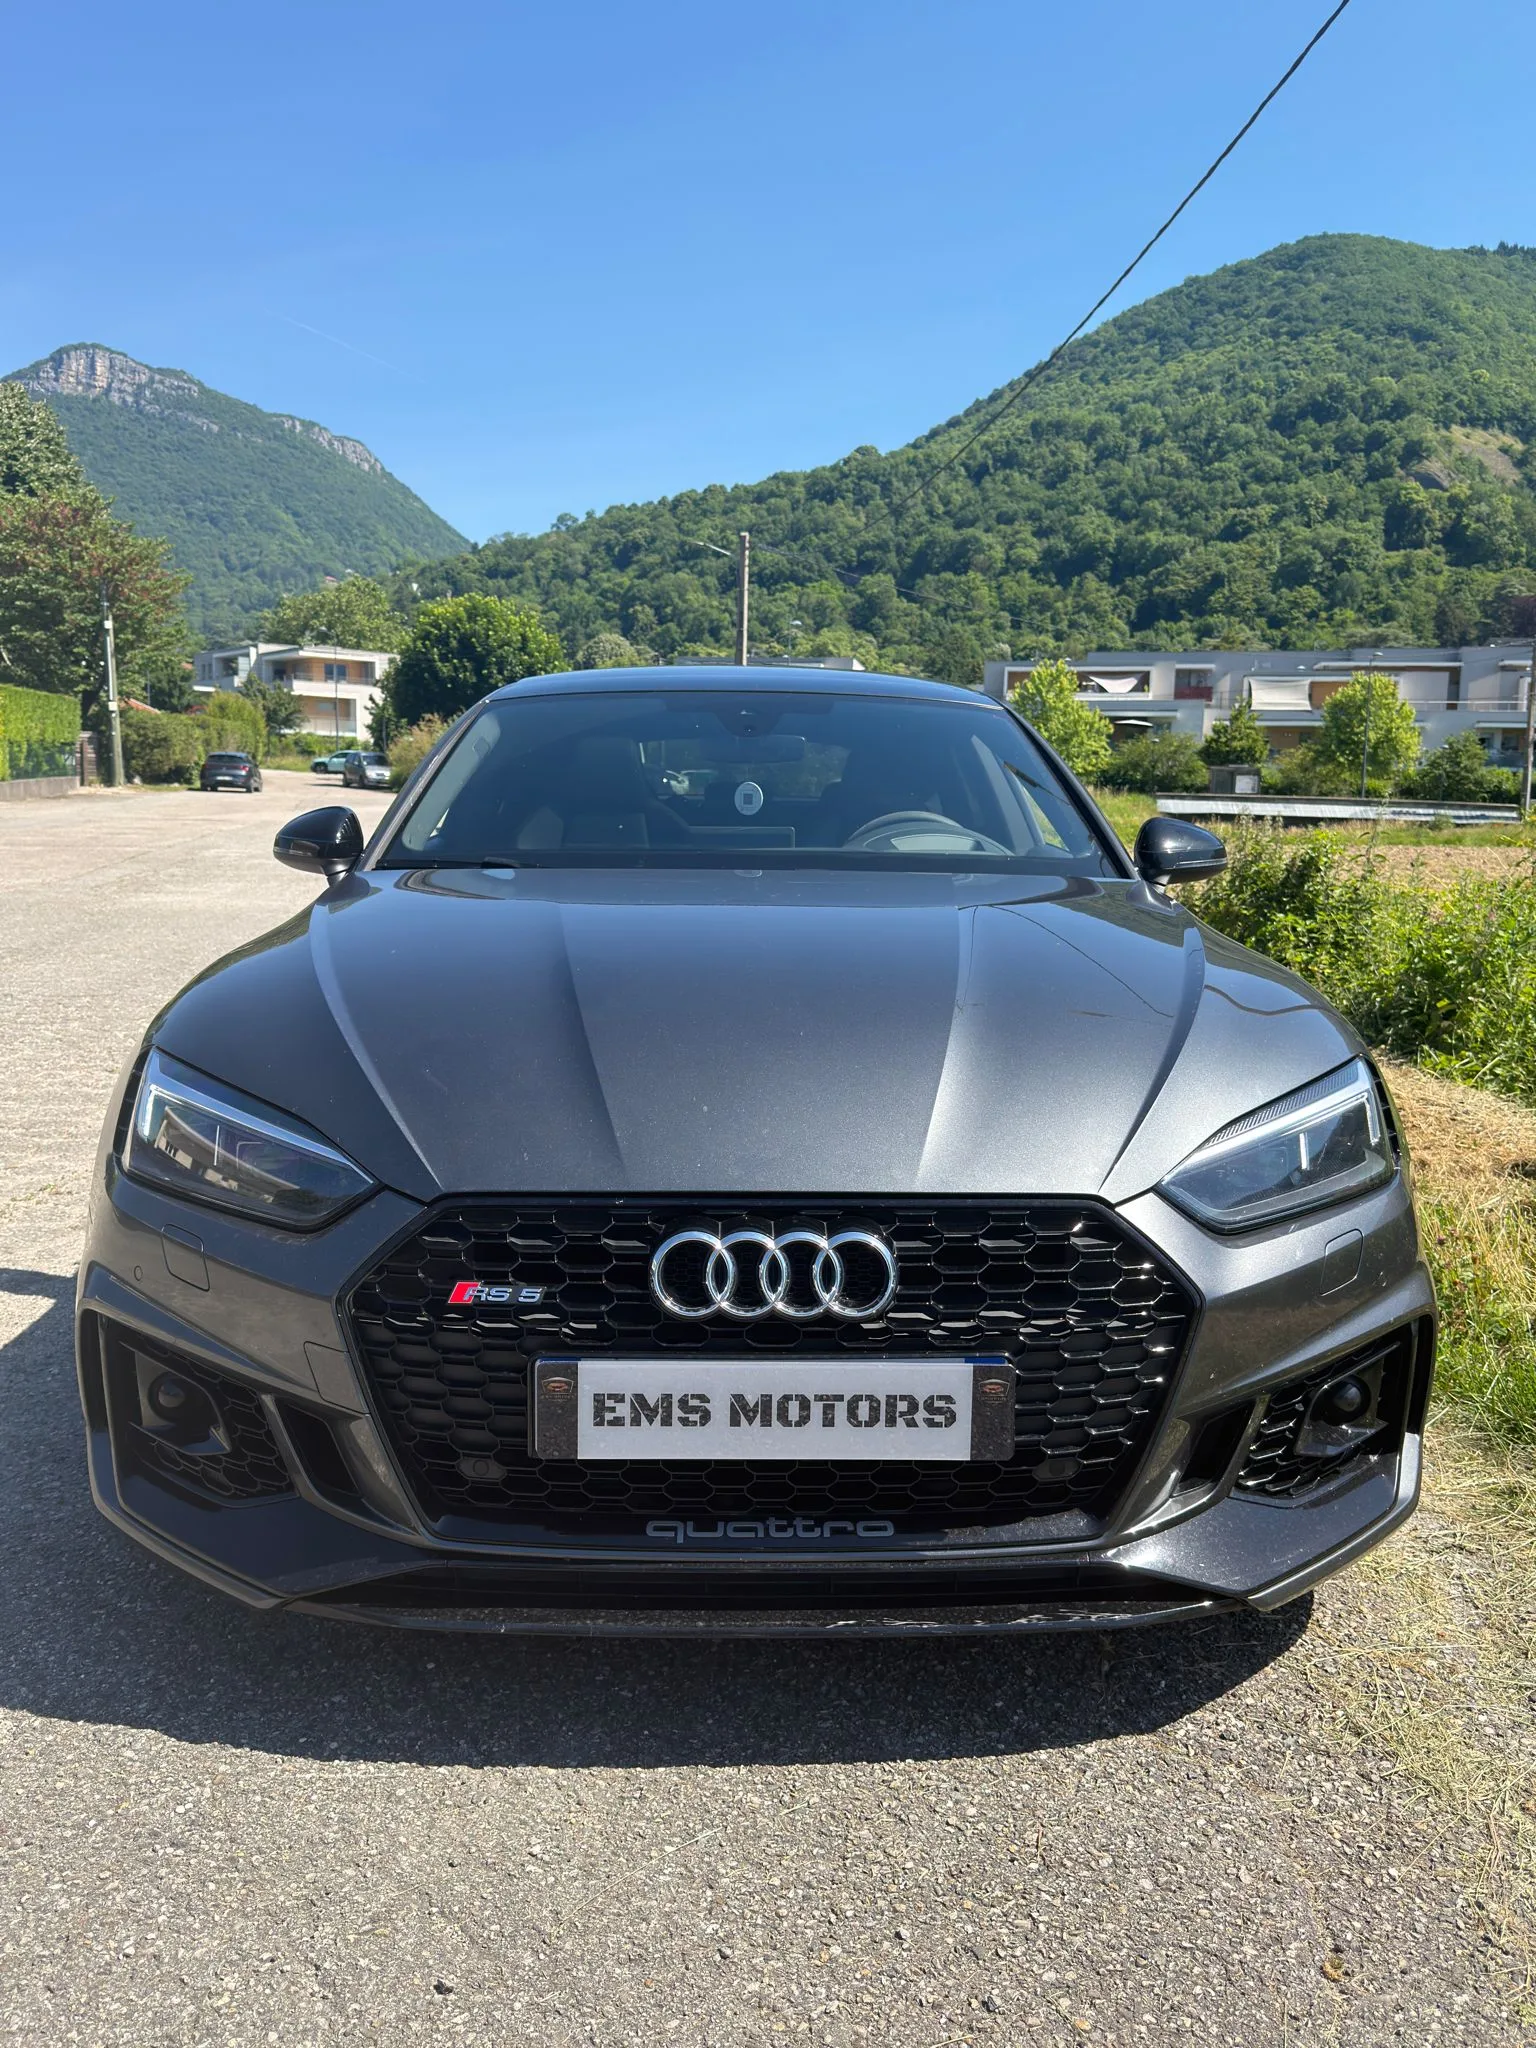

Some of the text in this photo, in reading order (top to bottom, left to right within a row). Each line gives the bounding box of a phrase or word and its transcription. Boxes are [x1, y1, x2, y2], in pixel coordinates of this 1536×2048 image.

[463, 1287, 543, 1303] RS 5
[592, 1393, 957, 1429] EMS MOTORS
[645, 1516, 895, 1544] quattro
